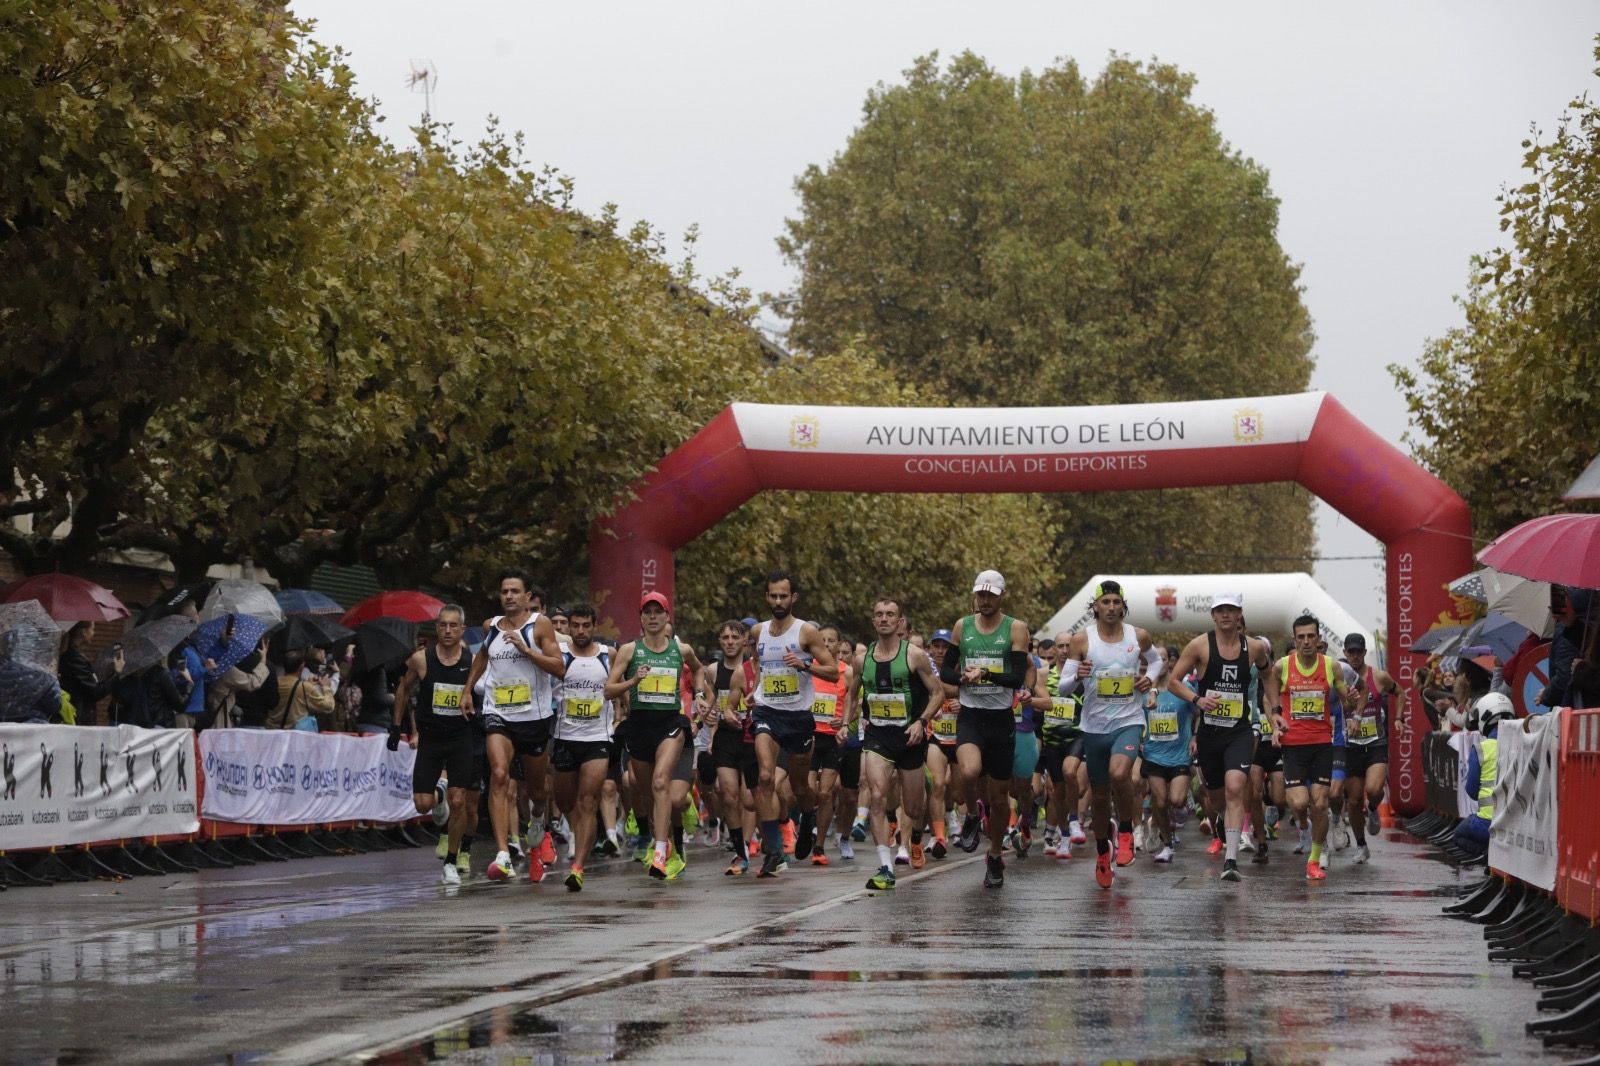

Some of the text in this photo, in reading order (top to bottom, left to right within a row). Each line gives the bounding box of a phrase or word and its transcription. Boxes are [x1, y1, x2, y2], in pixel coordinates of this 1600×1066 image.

[866, 417, 1185, 446] AYUNTAMIENTO DE LEÓN
[904, 455, 1148, 476] CONCEJALÍA DE DEPORTES
[1399, 552, 1412, 647] DEPORTES
[1399, 656, 1412, 679] DE
[773, 680, 787, 693] 35
[1113, 682, 1120, 694] 2
[444, 695, 457, 707] 46
[507, 690, 514, 703] 7
[577, 704, 591, 716] 50
[814, 702, 826, 713] 83
[883, 705, 891, 717] 5
[1217, 704, 1231, 717] 85
[1302, 702, 1315, 713] 32
[1155, 722, 1170, 733] 162
